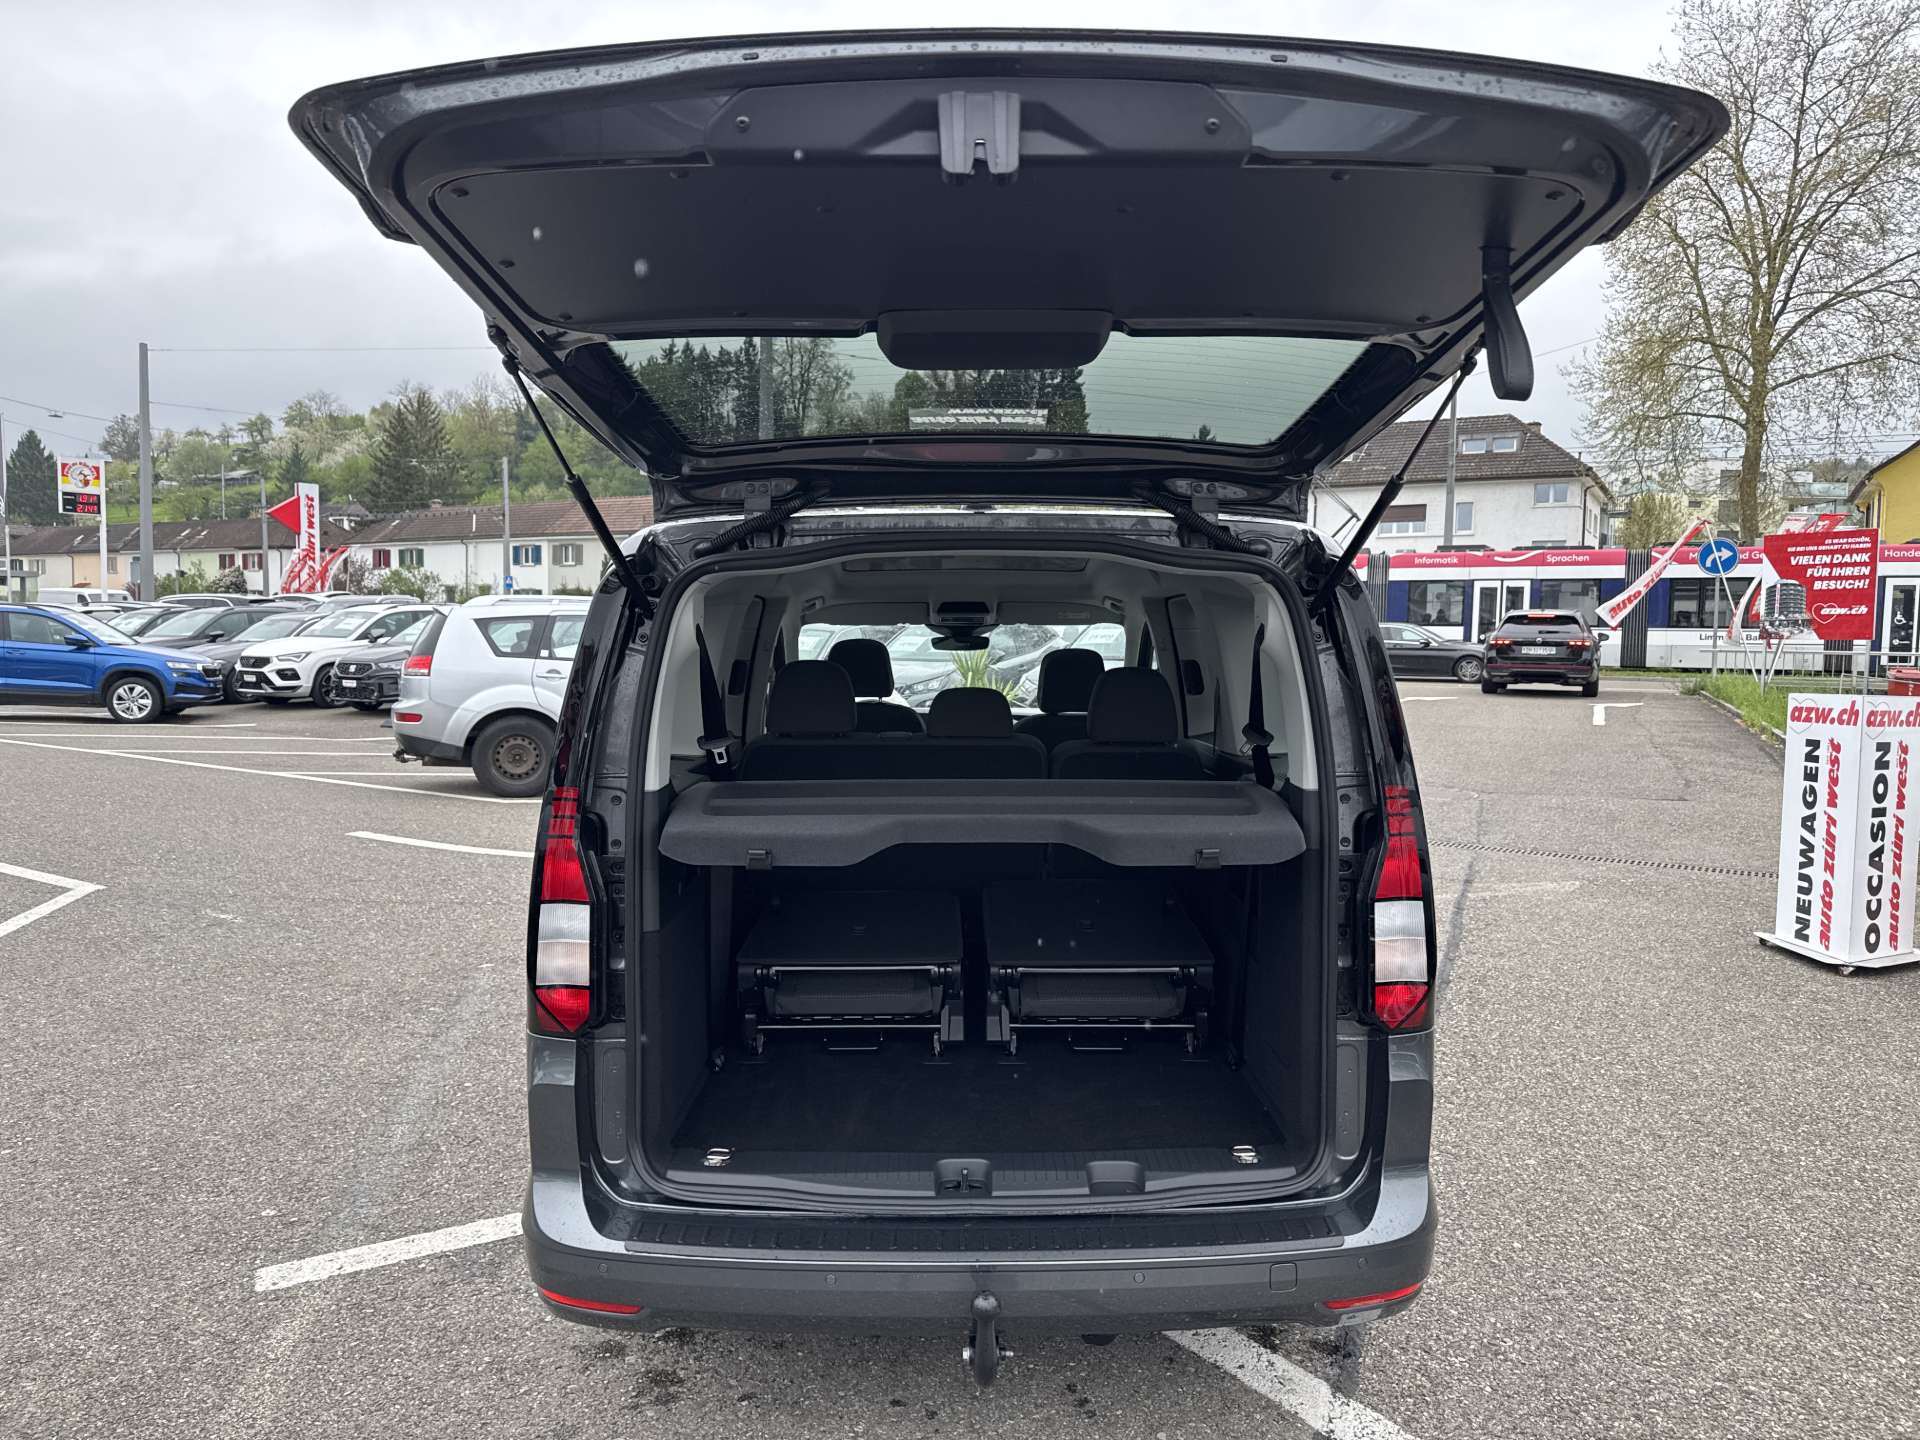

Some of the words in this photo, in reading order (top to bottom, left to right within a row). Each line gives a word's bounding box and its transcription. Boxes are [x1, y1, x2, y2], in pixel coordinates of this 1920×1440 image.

[305, 494, 315, 529] west
[1414, 556, 1458, 564] Informatik
[1546, 554, 1589, 564] Sprachen
[1790, 555, 1831, 565] VIELEN
[1832, 553, 1871, 563] DANK
[1806, 566, 1830, 577] FÜR
[1832, 566, 1871, 576] IHREN
[1813, 579, 1870, 590] BESUCH!
[1609, 590, 1642, 619] auto
[1790, 700, 1860, 726] azw.ch
[1866, 702, 1920, 727] azw.ch
[1794, 739, 1821, 943] NEUWAGEN
[1819, 879, 1834, 951] auto
[1827, 737, 1841, 808] west
[1864, 742, 1891, 953] OCCASION
[1889, 882, 1900, 951] auto
[1896, 740, 1909, 810] west
